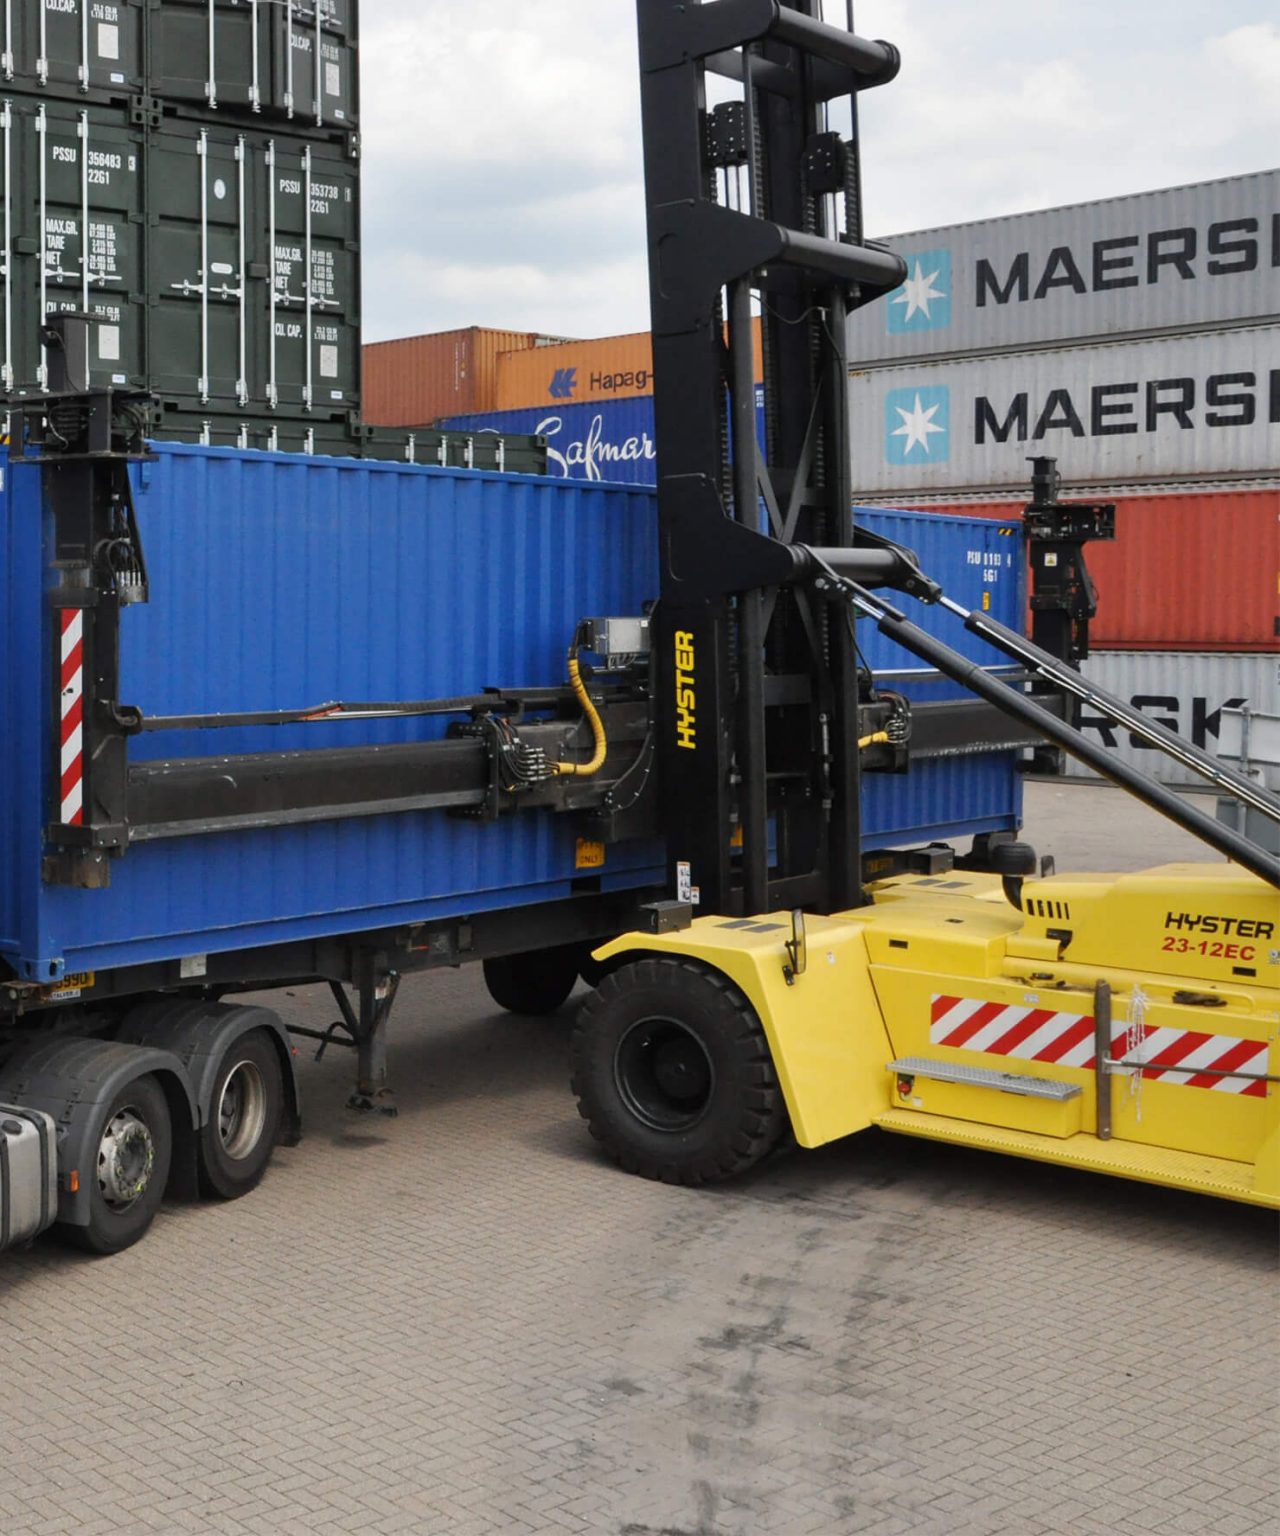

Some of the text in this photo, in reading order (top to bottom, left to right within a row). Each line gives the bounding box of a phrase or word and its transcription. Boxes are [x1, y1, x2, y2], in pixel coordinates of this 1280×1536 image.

[53, 146, 76, 163] PSSU
[88, 151, 121, 170] 356483
[88, 169, 110, 185] 22G1
[280, 179, 300, 195] PSSU
[310, 199, 329, 215] 22G1
[46, 218, 79, 236] MAX.GR.
[46, 234, 65, 250] TARE
[46, 250, 61, 266] NET
[275, 246, 303, 263] MAX.GR.
[975, 212, 1280, 308] MAERS
[276, 261, 292, 276] TARE
[974, 369, 1280, 445] MAERS
[534, 414, 657, 481] Safmar
[675, 631, 696, 750] HYSTER
[1073, 695, 1249, 750] RSK
[1164, 911, 1275, 940] HYSTER
[1161, 936, 1256, 961] 23-12EC
